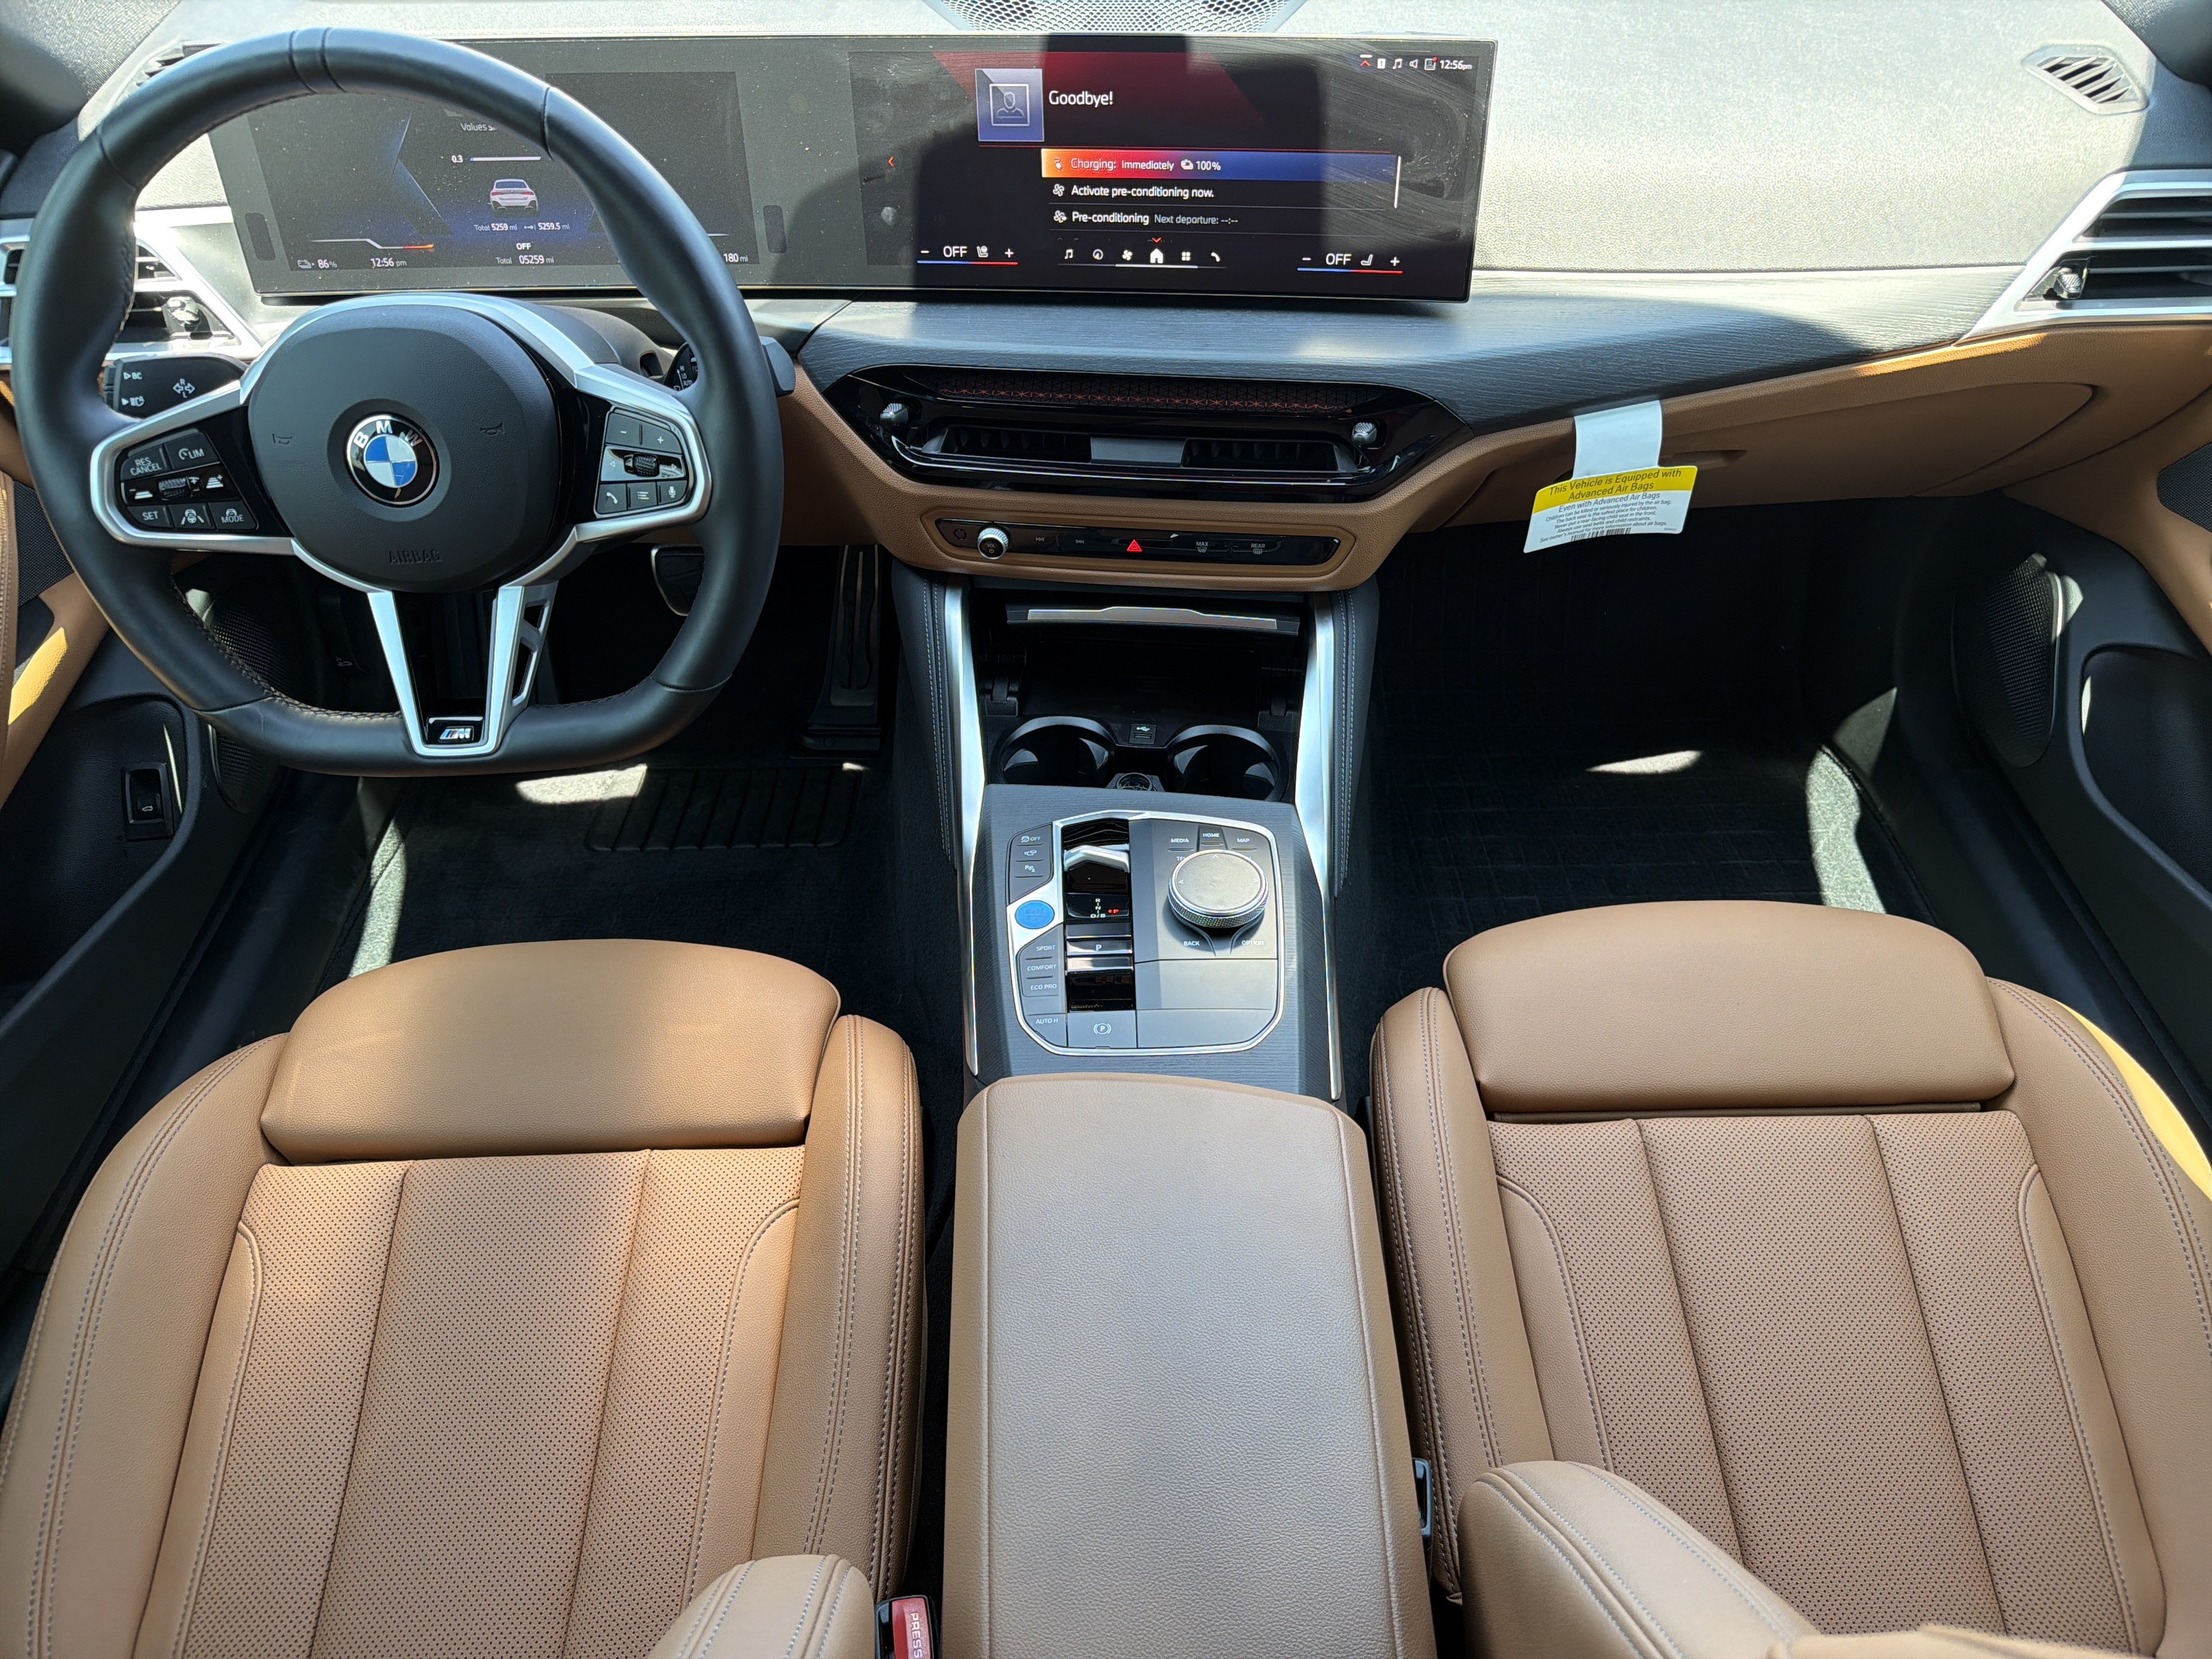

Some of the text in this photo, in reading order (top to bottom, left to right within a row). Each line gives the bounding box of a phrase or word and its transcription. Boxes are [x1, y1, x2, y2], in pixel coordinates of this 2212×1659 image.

[1440, 60, 1472, 70] 12:56pm
[1049, 90, 1113, 108] Goodbye!
[460, 122, 487, 131] Values
[451, 154, 463, 163] 0.3
[1071, 158, 1221, 172] Charging: Immediately 100%
[1071, 185, 1109, 196] Activate
[1111, 186, 1189, 200] pre-conditioning
[1072, 211, 1149, 225] Pre-conditioning
[1154, 214, 1174, 224] Next
[1176, 216, 1218, 225] departure:
[491, 223, 508, 231] 5259
[538, 222, 561, 230] 5259.5
[723, 253, 739, 262] 180
[943, 245, 967, 258] OFF
[495, 256, 512, 264] Total
[519, 255, 545, 264] 05259
[1325, 253, 1352, 265] OFF
[353, 420, 423, 449] BMW
[188, 448, 205, 459] LIM
[134, 457, 152, 467] RES
[130, 463, 162, 476] CANCEL
[1549, 486, 1566, 495] This
[1570, 477, 1602, 490] Vehicle
[1615, 469, 1660, 484] Equipped
[1661, 469, 1681, 478] with
[1568, 482, 1654, 501] Advanced Air Bags
[1577, 500, 1591, 508] with
[1593, 494, 1629, 505] Advanced
[142, 511, 159, 521] SET
[221, 514, 245, 523] MODE
[389, 549, 442, 564] AIRBAG
[910, 1611, 923, 1658] PRESS
